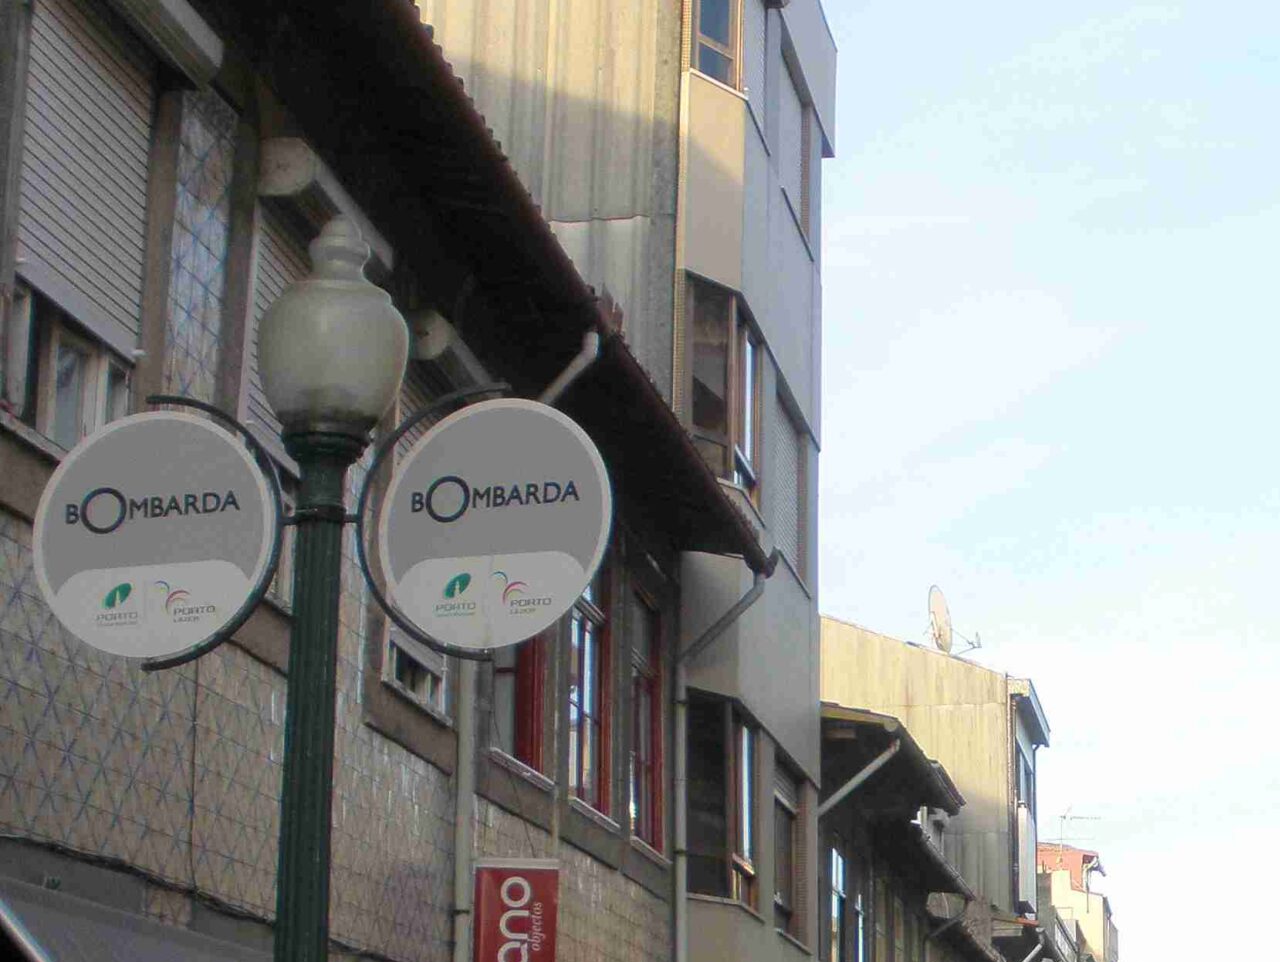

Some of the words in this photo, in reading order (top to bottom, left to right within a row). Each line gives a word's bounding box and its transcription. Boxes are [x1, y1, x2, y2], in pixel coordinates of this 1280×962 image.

[65, 487, 240, 535] BOMBARDA
[410, 475, 580, 523] BOMBARDA
[173, 604, 216, 616] PORTO
[434, 602, 477, 612] PORTO
[509, 597, 553, 608] PORTO
[530, 901, 545, 953] objectos
